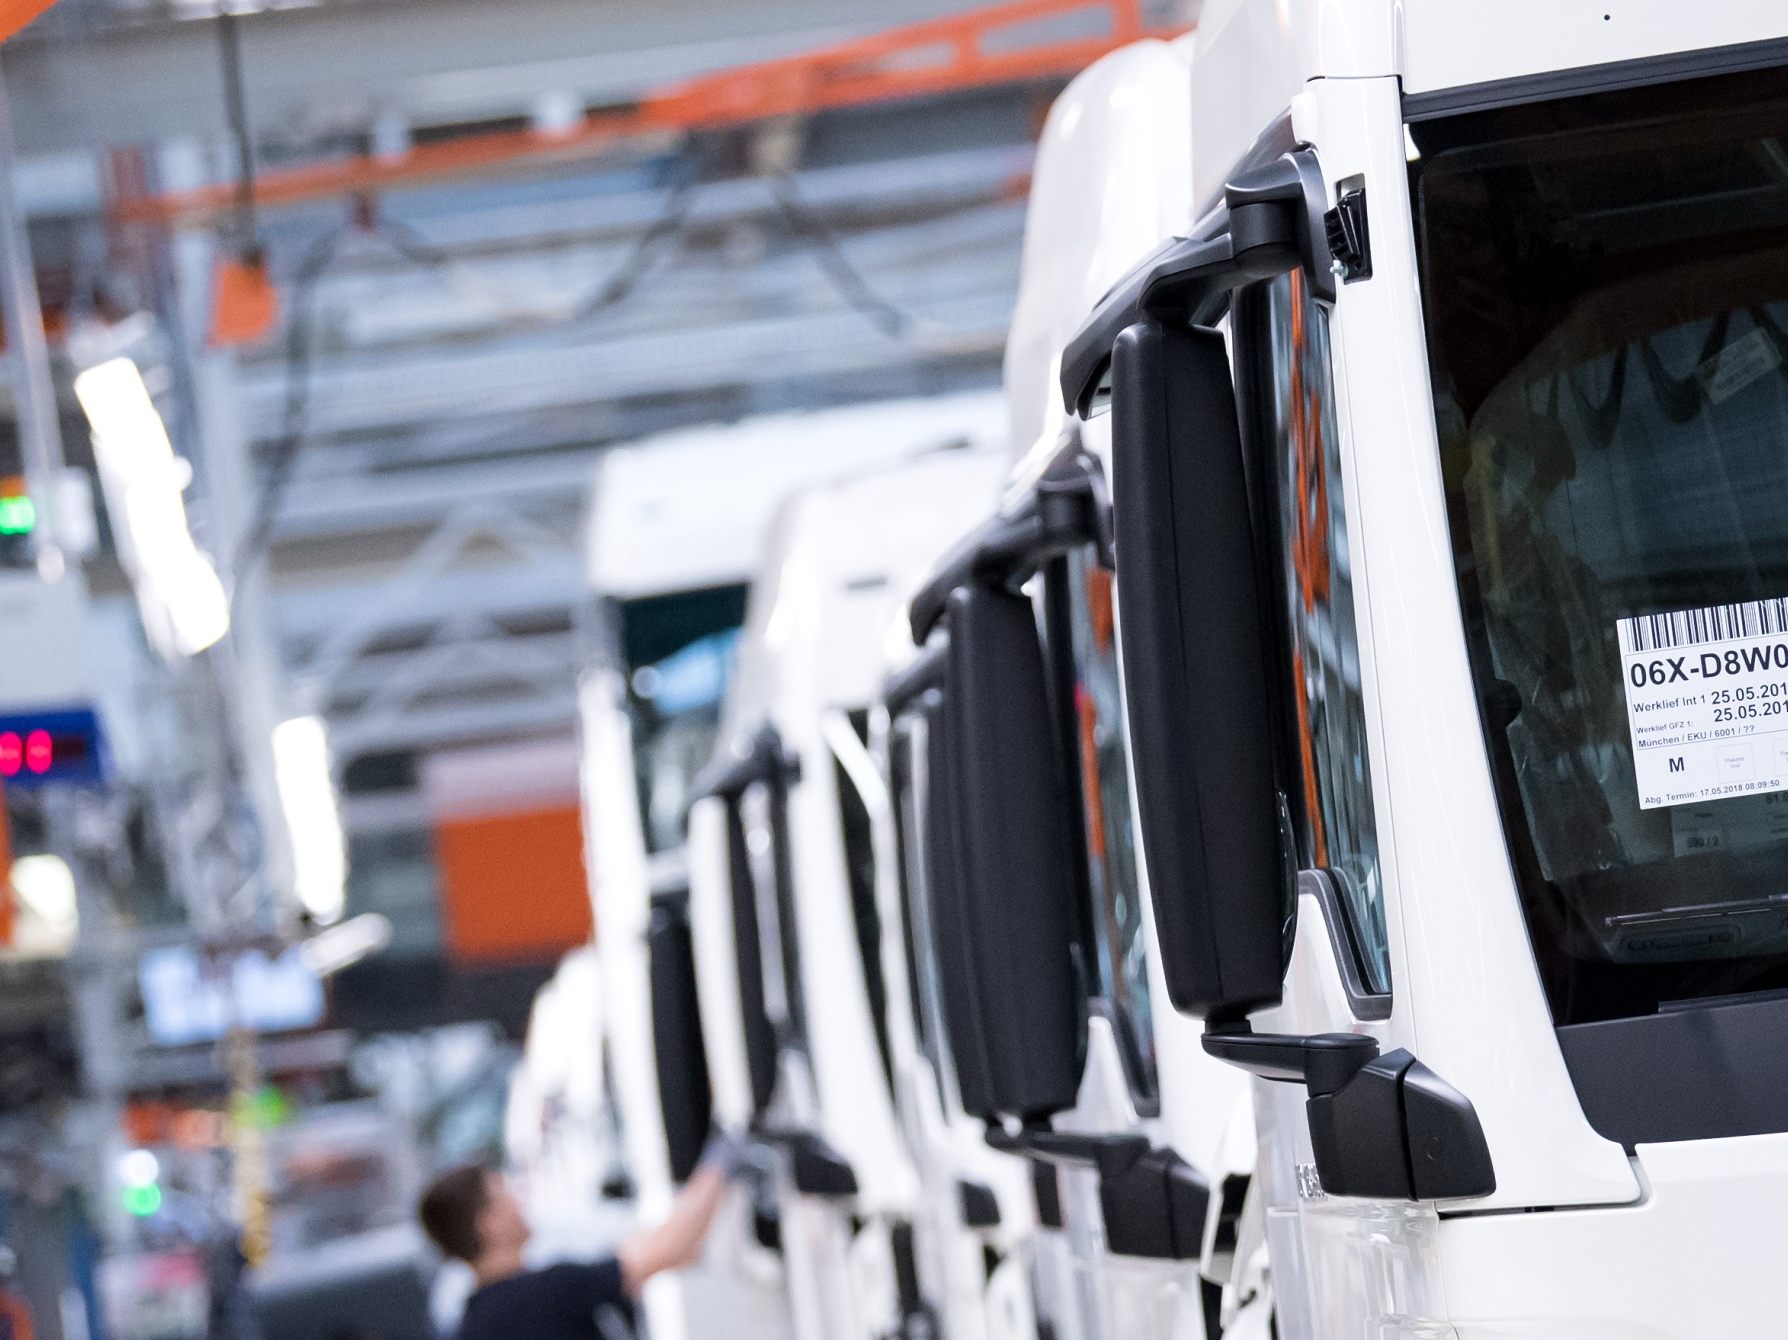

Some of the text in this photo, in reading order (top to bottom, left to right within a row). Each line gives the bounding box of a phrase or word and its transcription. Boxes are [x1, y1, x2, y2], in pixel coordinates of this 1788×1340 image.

[1634, 698, 1680, 713] Werklief
[1683, 696, 1697, 707] Int
[1700, 694, 1706, 704] 1
[1636, 724, 1667, 734] Werklief
[1670, 722, 1685, 730] GFZ
[1638, 734, 1680, 748] München
[1687, 732, 1707, 742] EKU
[1714, 728, 1736, 738] 6001
[1744, 725, 1755, 733] ??
[1669, 757, 1685, 772] M
[1666, 790, 1698, 802] Termin:
[1700, 784, 1742, 796] 17.05.2018
[1745, 780, 1780, 790] 08:09:50
